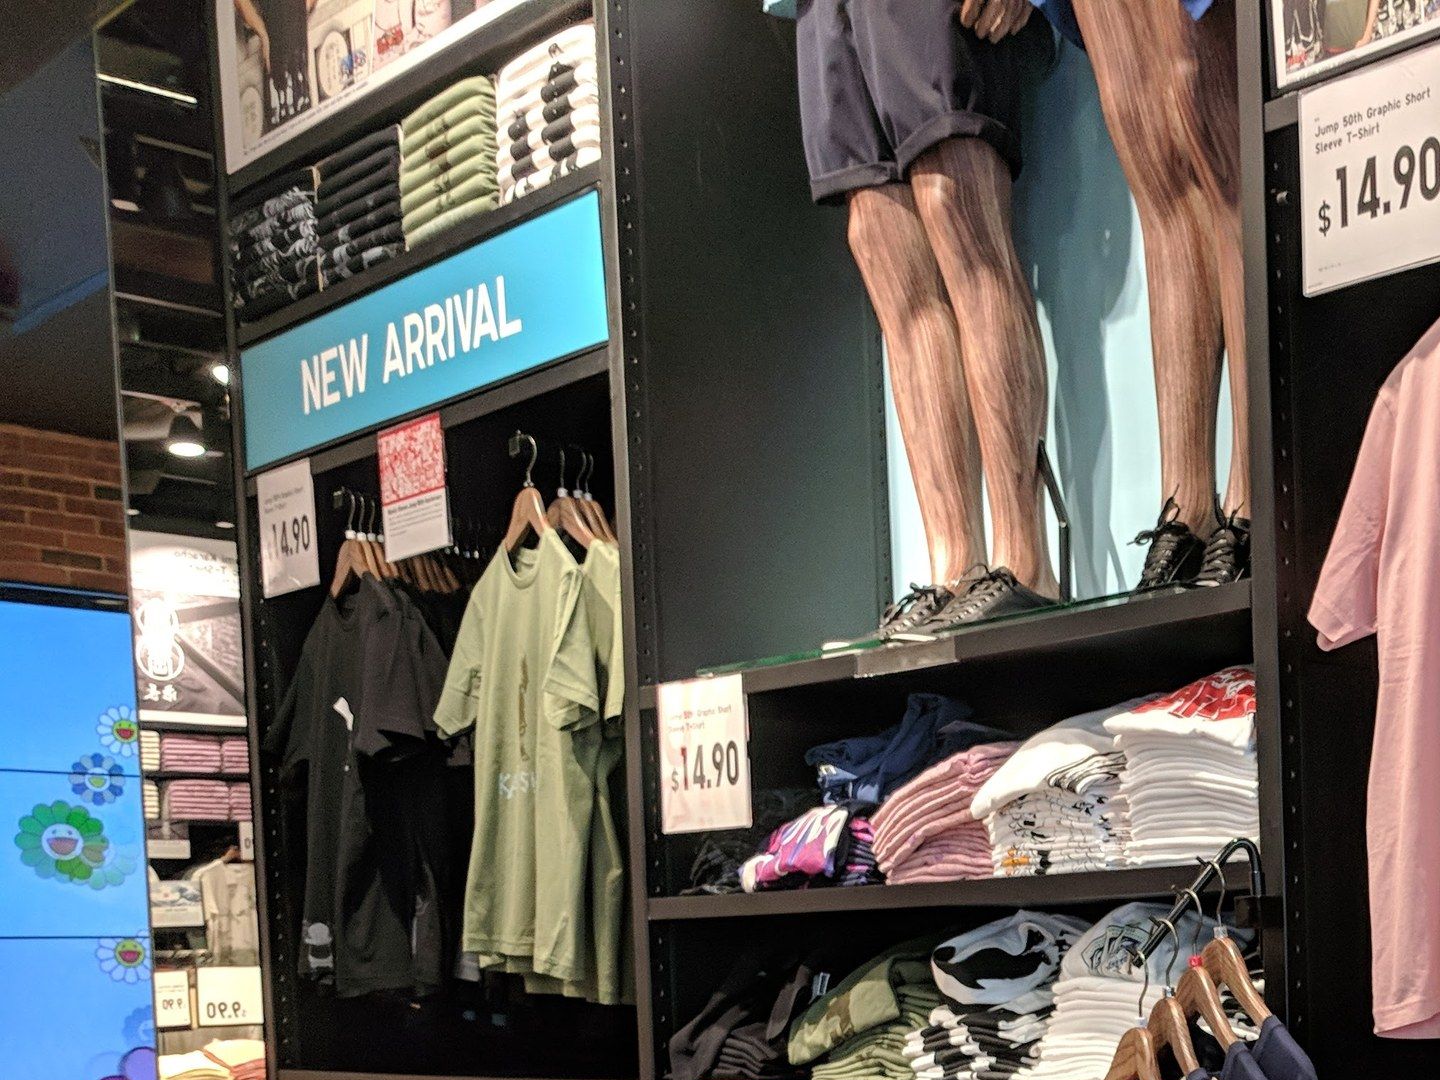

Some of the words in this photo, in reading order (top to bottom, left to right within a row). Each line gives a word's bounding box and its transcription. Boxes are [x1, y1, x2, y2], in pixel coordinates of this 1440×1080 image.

[1314, 119, 1339, 137] Jump
[1342, 112, 1363, 128] 50th
[1366, 98, 1402, 119] Graphic
[1405, 86, 1431, 106] Short
[1315, 137, 1343, 154] Sleeve
[1346, 122, 1380, 144] T-Shirt
[300, 333, 369, 416] NEW
[382, 275, 523, 384] ARRIVAL
[671, 740, 739, 792] $14.90
